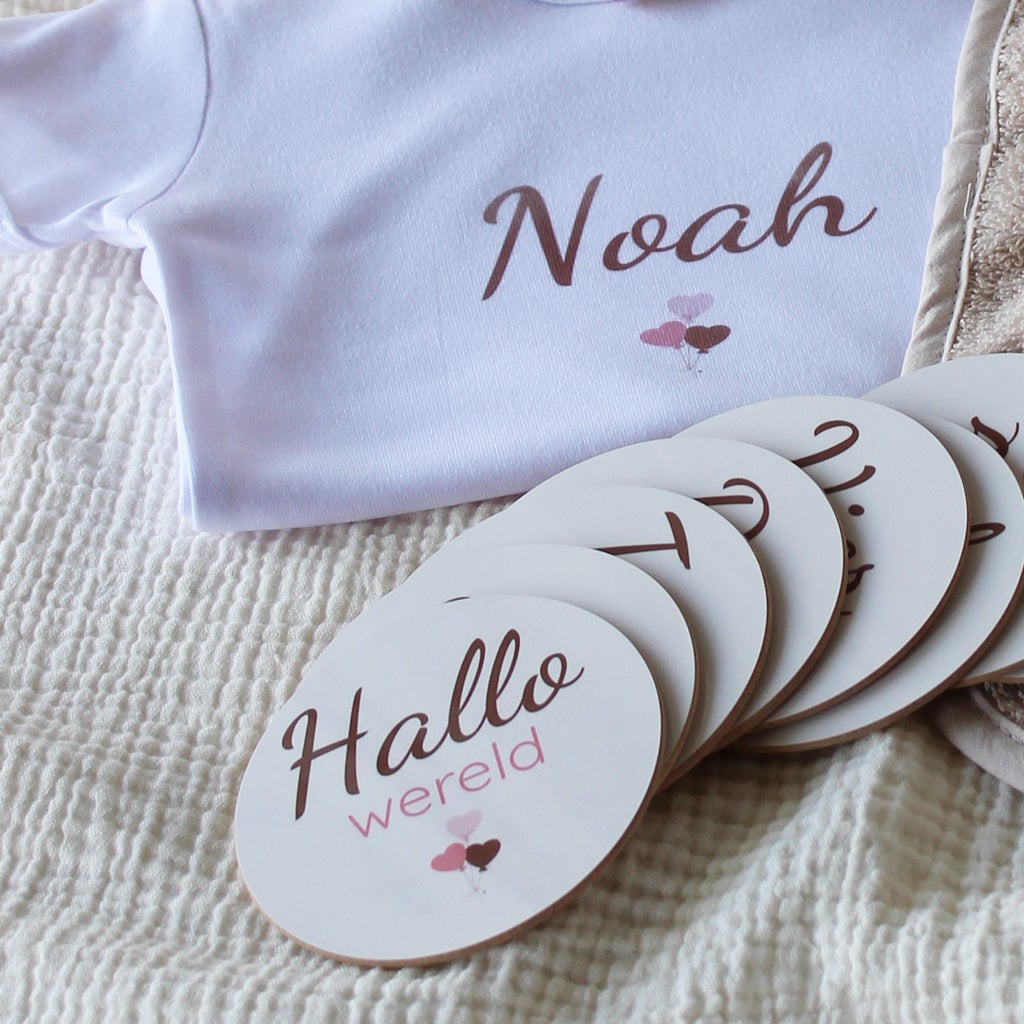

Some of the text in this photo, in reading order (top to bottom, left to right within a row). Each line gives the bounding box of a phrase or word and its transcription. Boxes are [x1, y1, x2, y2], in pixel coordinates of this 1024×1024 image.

[482, 141, 878, 301] Noah
[282, 628, 584, 821] Hallo
[347, 725, 546, 839] wereld
